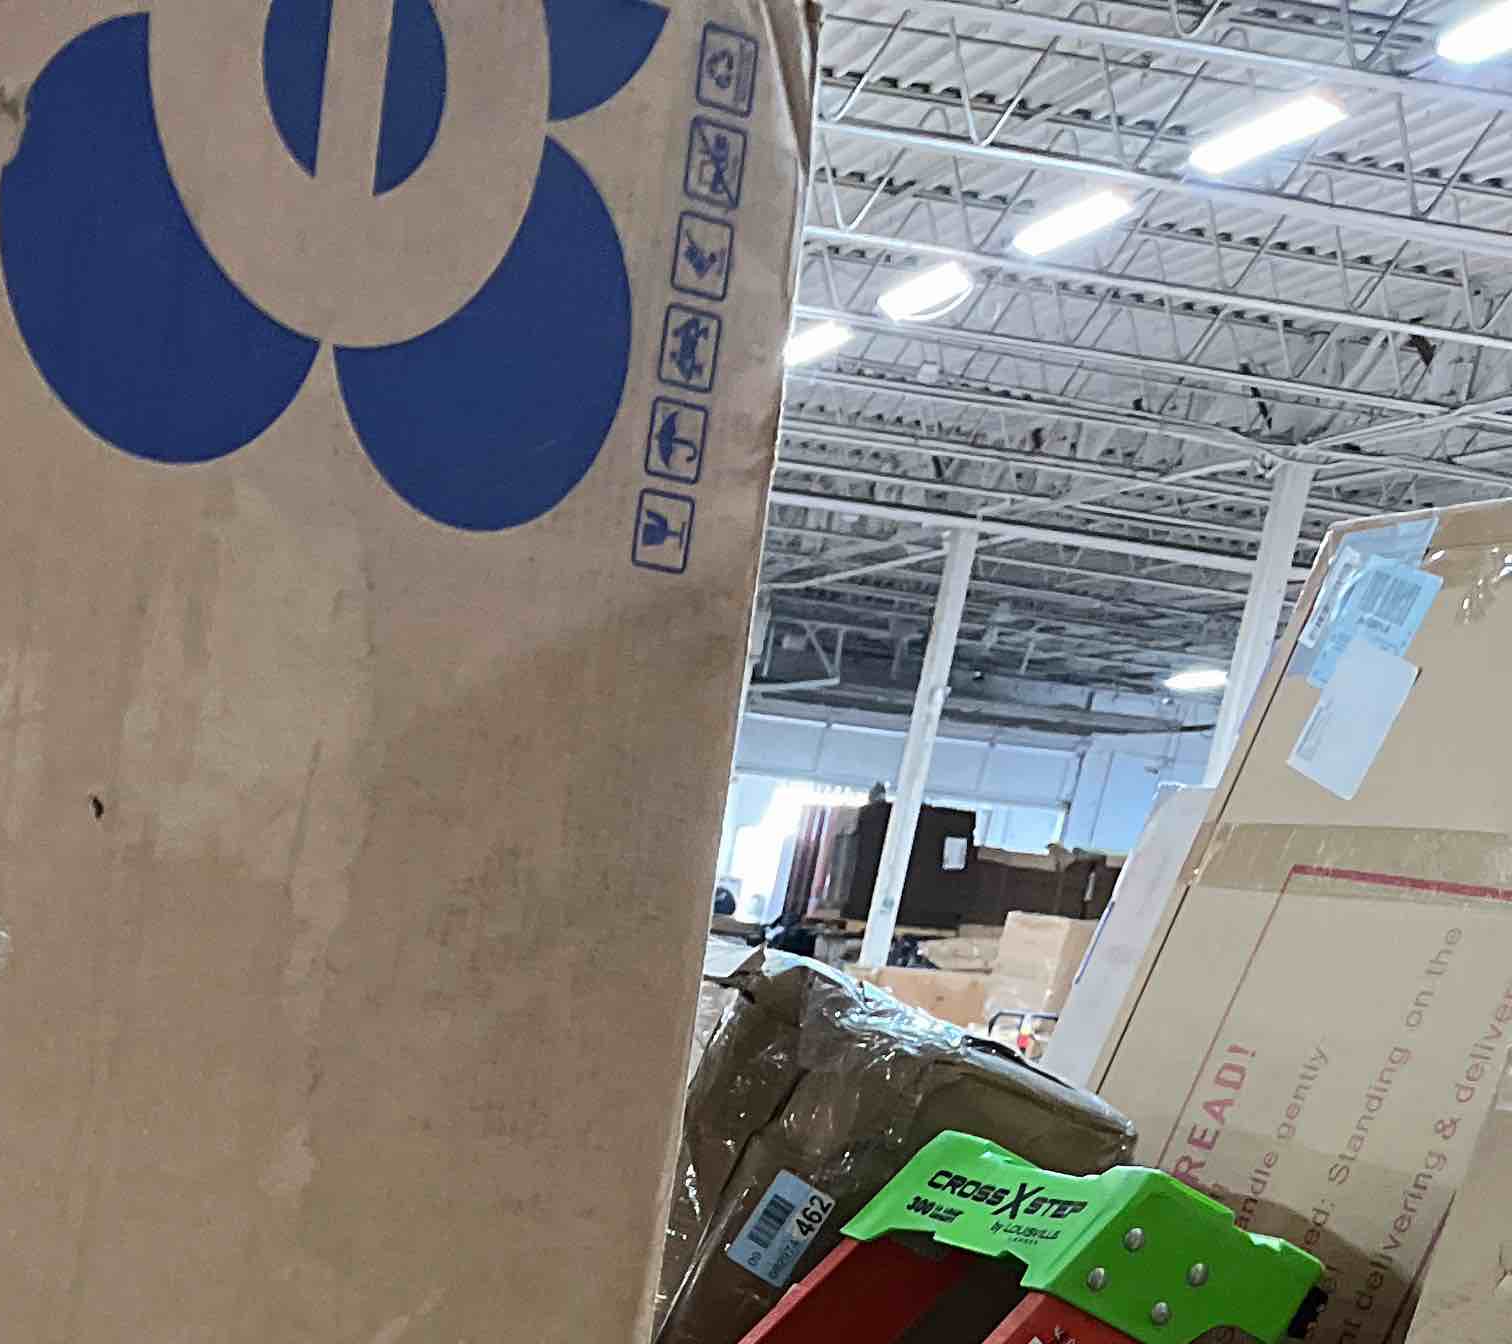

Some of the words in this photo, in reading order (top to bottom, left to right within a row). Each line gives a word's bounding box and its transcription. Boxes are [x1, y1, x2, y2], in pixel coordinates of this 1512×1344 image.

[1172, 1043, 1257, 1183] READ!
[1233, 1151, 1279, 1230] andle
[1277, 1047, 1329, 1143] gently
[1328, 1045, 1411, 1186] Standing
[1404, 989, 1434, 1029] on
[1426, 926, 1464, 977] the
[796, 1195, 832, 1236] 462
[1356, 1149, 1448, 1311] delivering
[1433, 1117, 1462, 1141] &
